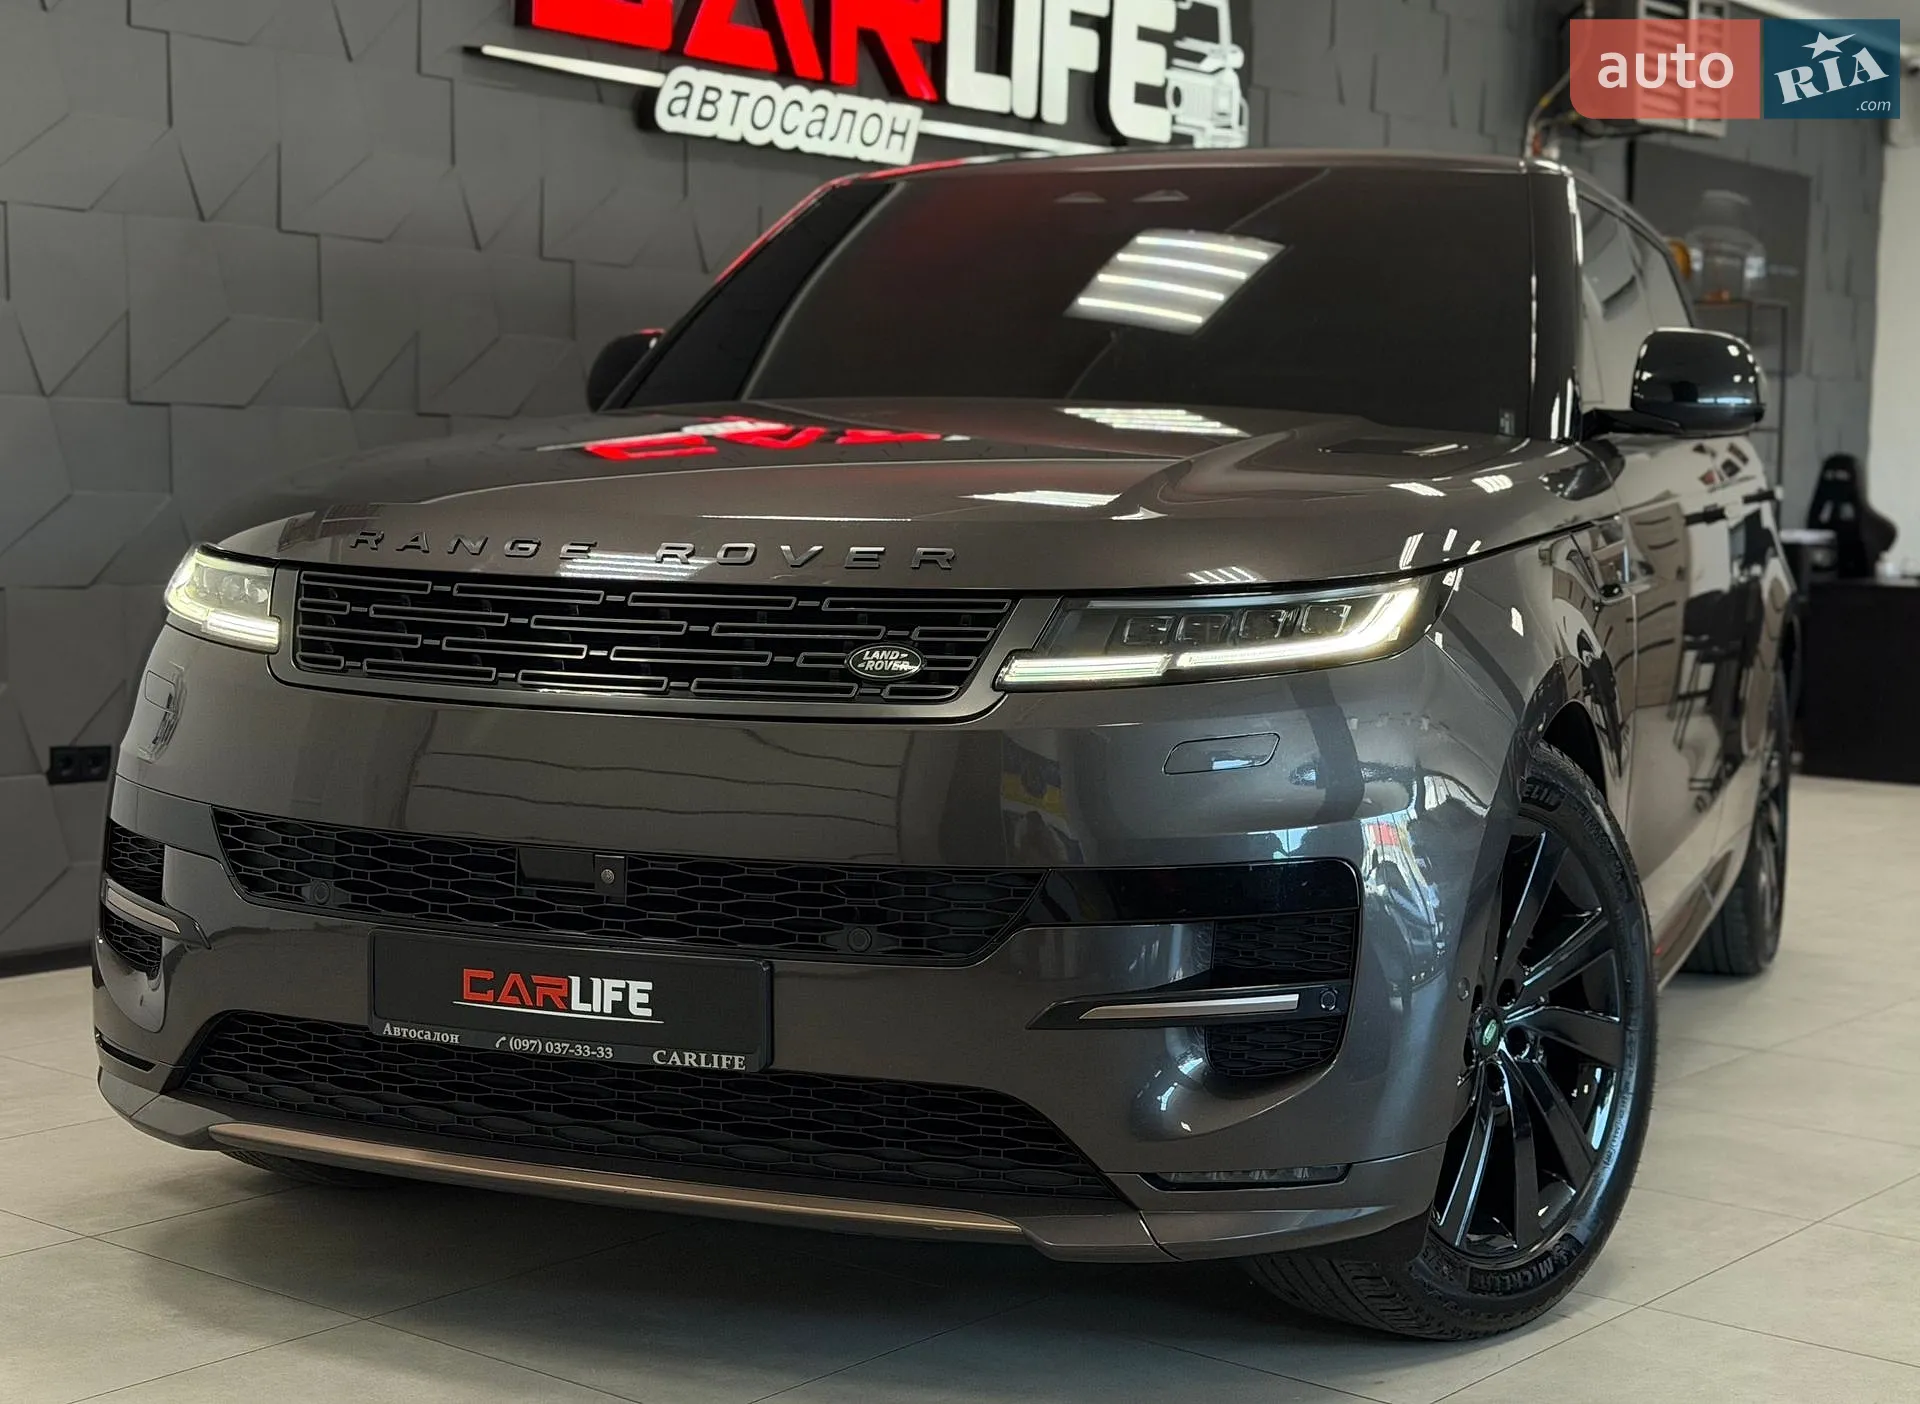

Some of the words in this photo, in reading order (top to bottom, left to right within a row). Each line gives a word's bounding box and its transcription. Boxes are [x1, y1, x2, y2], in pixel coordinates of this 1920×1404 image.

[666, 79, 912, 152] автосалон
[350, 529, 597, 560] RANGE
[655, 542, 956, 570] ROVER
[462, 968, 653, 1017] CARLIFE
[382, 1022, 460, 1044] Автосалон
[509, 1036, 543, 1054] (097)
[545, 1041, 613, 1059] 037-33-33
[652, 1050, 746, 1071] CARLIFE
